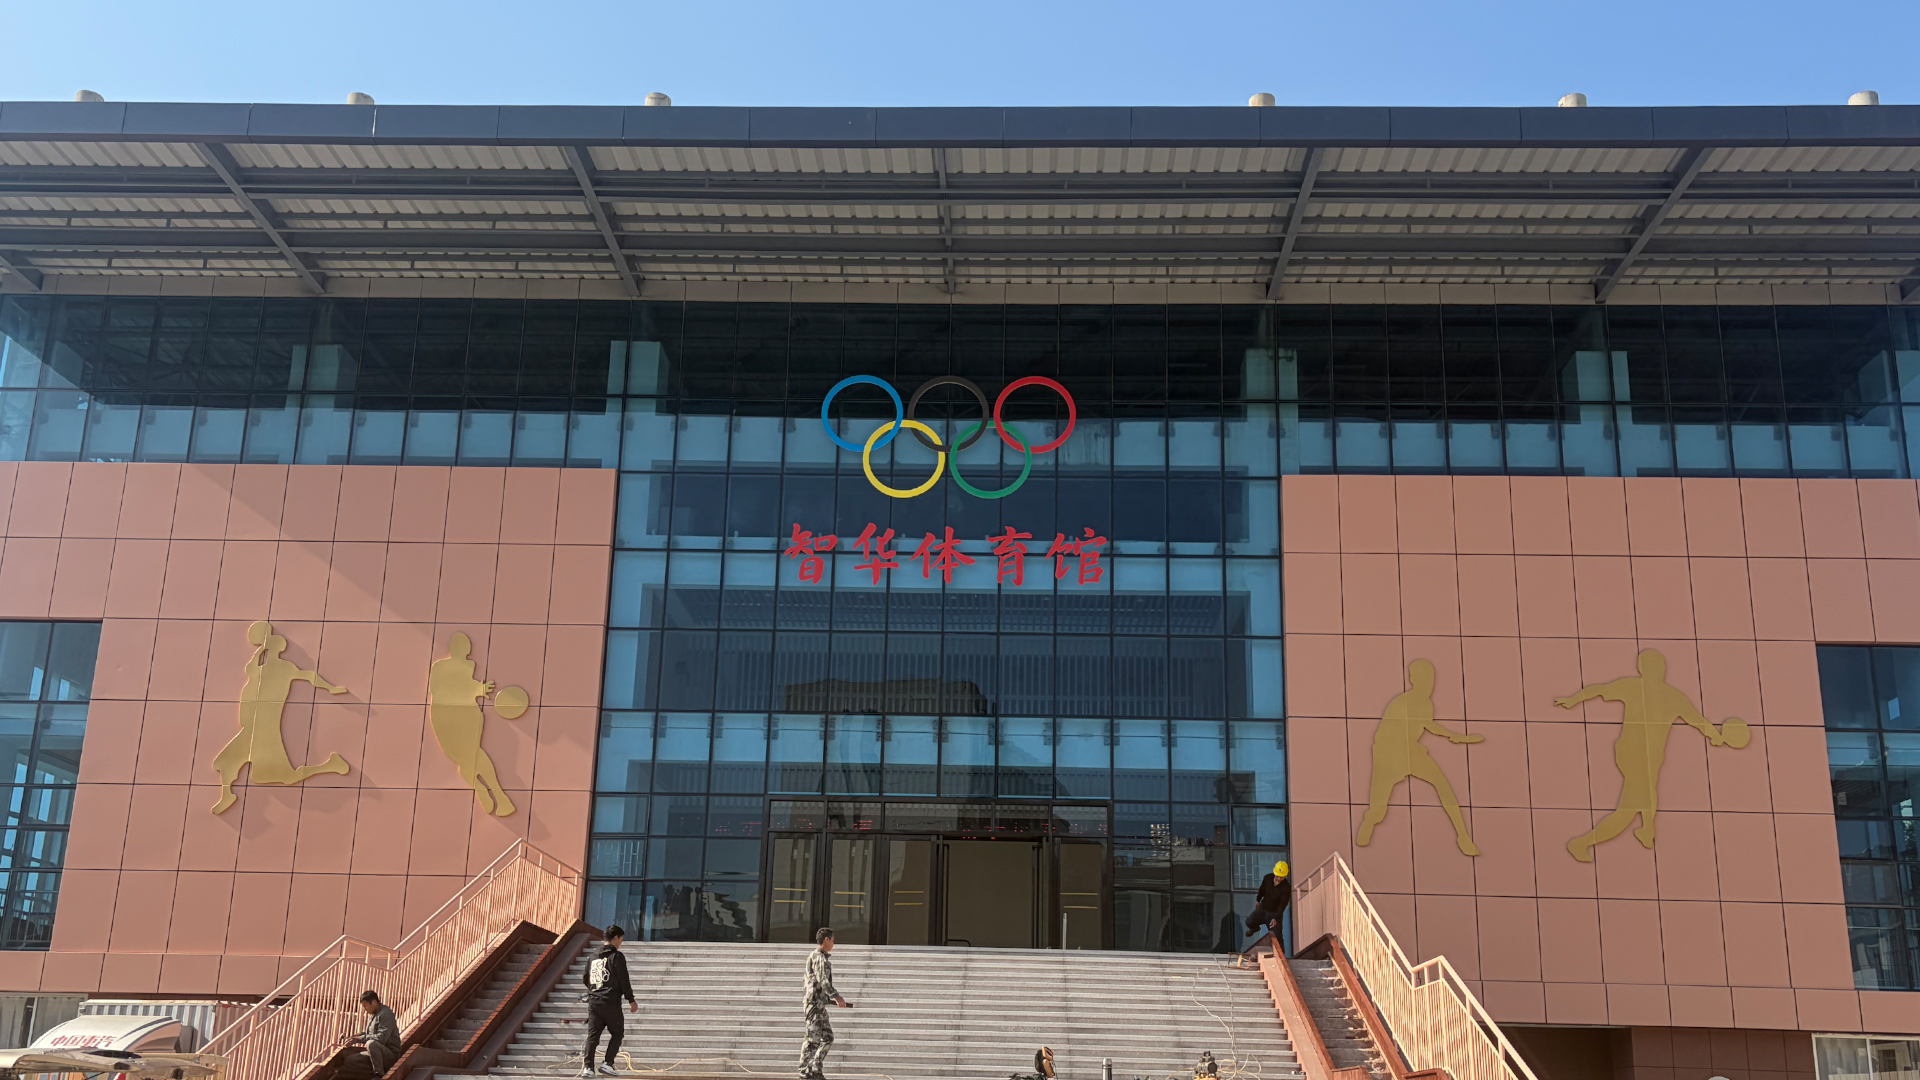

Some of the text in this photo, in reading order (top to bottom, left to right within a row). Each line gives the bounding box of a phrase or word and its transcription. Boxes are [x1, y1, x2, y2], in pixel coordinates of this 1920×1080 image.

[784, 523, 1107, 586] 智华体育馆
[50, 1035, 117, 1048] 中国重汽
